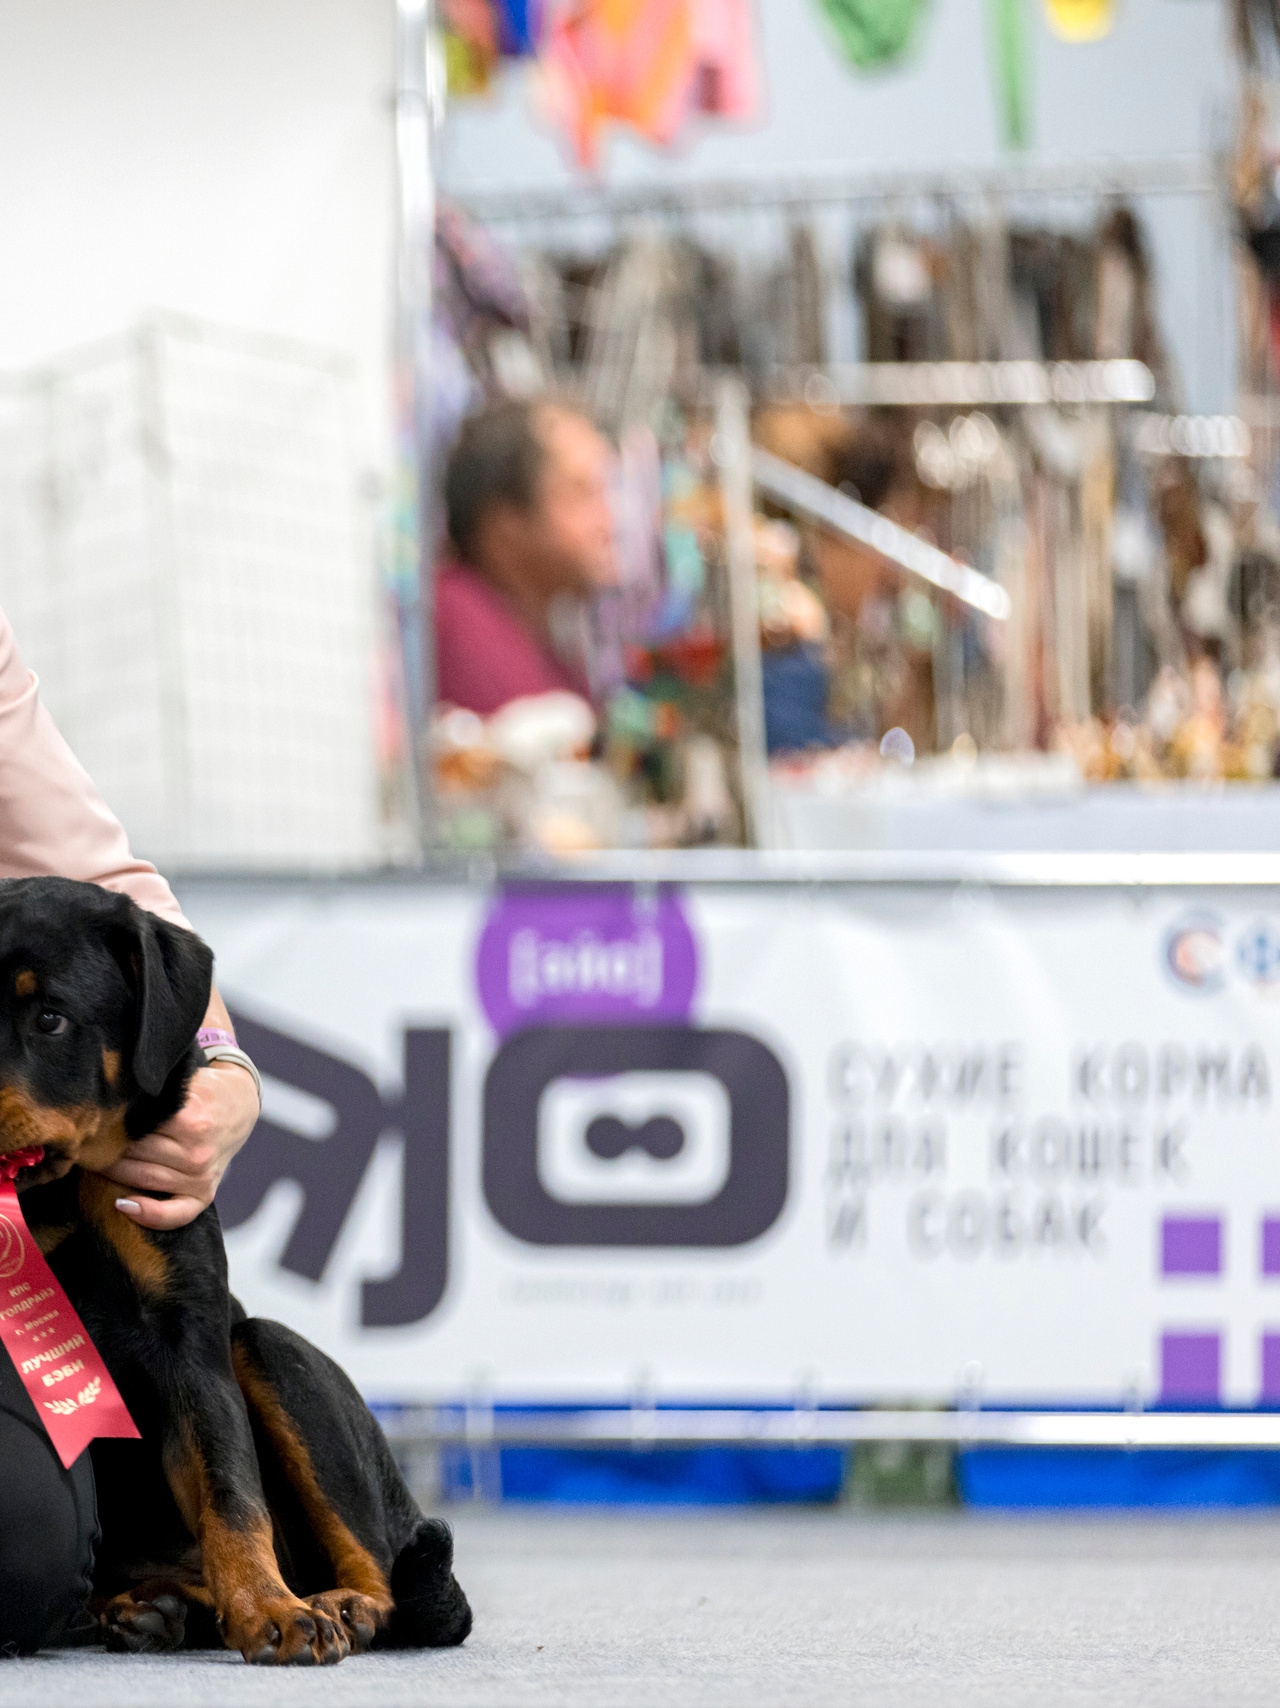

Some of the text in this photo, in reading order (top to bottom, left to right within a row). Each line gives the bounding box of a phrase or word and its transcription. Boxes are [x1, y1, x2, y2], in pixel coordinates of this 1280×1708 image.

[1071, 1041, 1271, 1110] КОРМА
[990, 1116, 1189, 1185] КОШЕК
[908, 1190, 1108, 1260] СОБАК
[21, 1334, 85, 1374] ЛУЧШИЙ
[41, 1359, 85, 1387] БЭБИ
